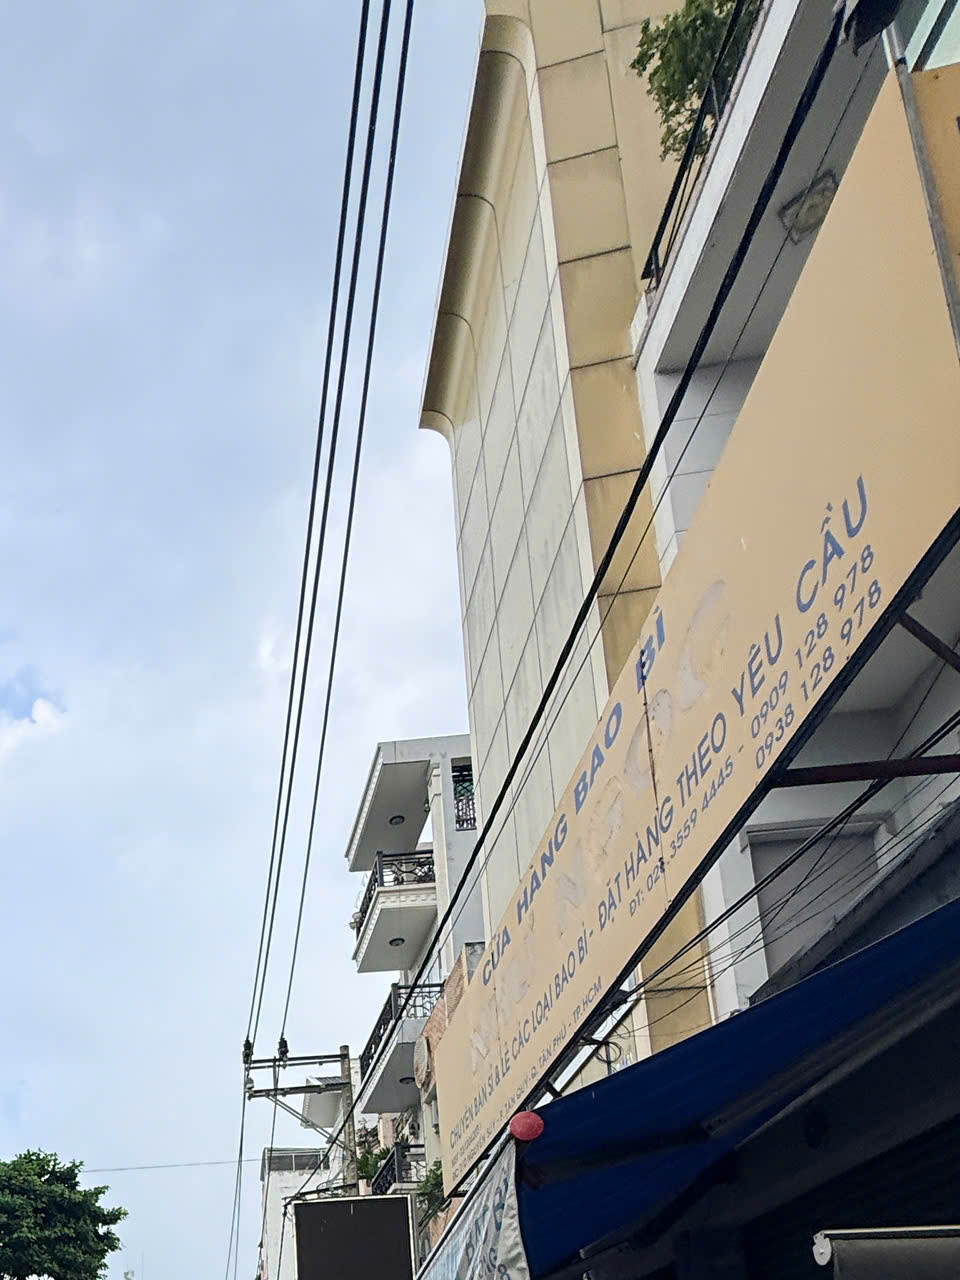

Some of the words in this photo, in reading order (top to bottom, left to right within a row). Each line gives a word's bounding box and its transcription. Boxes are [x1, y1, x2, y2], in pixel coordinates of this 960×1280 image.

[483, 924, 511, 986] CỬA
[517, 813, 568, 925] HÀNG
[573, 701, 623, 815] BAO
[635, 606, 666, 694] BÌ
[532, 988, 554, 1032] LOẠI
[554, 952, 577, 1000] BAO
[576, 922, 589, 966] BÌ
[598, 871, 623, 931] ĐẶT
[624, 795, 674, 885] HÀNG
[676, 711, 727, 808] THEO
[731, 613, 784, 717] YÊU
[796, 472, 868, 613] CẦU
[701, 755, 734, 812] 4445
[751, 670, 788, 739] 0909
[795, 612, 828, 670] 128
[833, 544, 874, 612] 978
[756, 703, 795, 770] 0938
[800, 645, 835, 703] 128
[840, 579, 882, 646] 978
